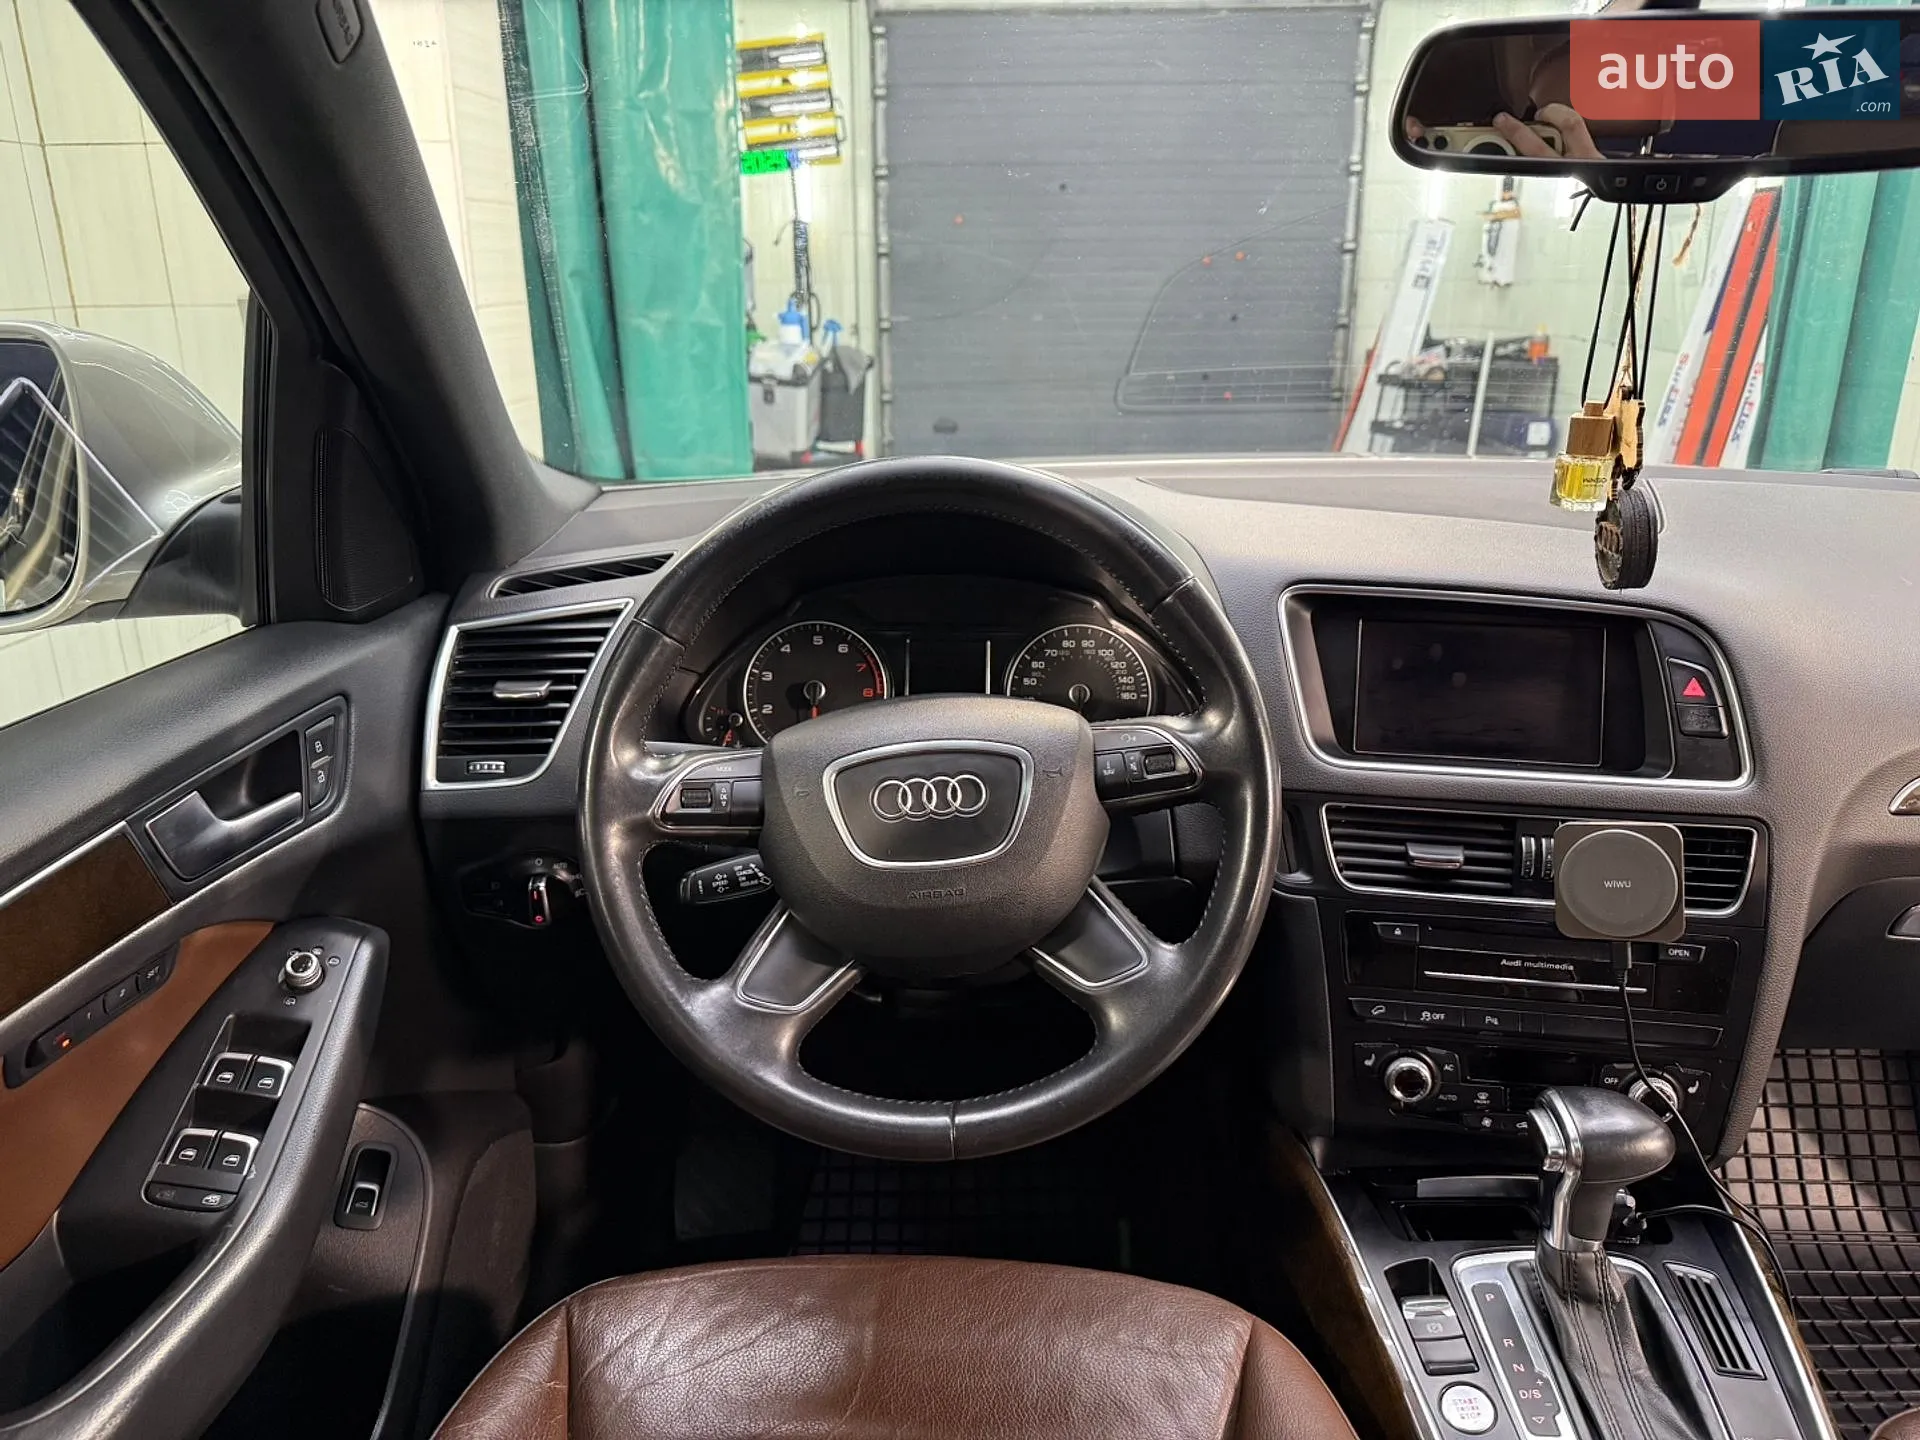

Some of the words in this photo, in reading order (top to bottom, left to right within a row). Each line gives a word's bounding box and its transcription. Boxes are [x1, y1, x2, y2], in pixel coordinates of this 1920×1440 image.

[813, 635, 823, 645] 5
[1061, 640, 1076, 648] 80
[780, 644, 791, 653] 4
[838, 644, 849, 653] 6
[1044, 649, 1058, 657] 70
[1098, 649, 1114, 657] 100
[856, 664, 866, 673] 7
[1110, 661, 1127, 669] 120
[762, 671, 773, 681] 3
[1118, 676, 1135, 684] 140
[1023, 677, 1037, 686] 50
[1120, 692, 1137, 700] 160
[762, 704, 773, 714] 2
[1603, 879, 1631, 888] WIWU
[1668, 948, 1690, 958] OPEN
[1500, 958, 1522, 969] Audi
[1524, 960, 1575, 971] multimedia
[1432, 1012, 1446, 1021] OFF
[1443, 1064, 1455, 1072] AC
[1604, 1077, 1618, 1085] OFF
[1485, 1293, 1495, 1302] P
[1503, 1338, 1514, 1347] R
[1513, 1363, 1525, 1372] N
[1519, 1389, 1542, 1399] D/S
